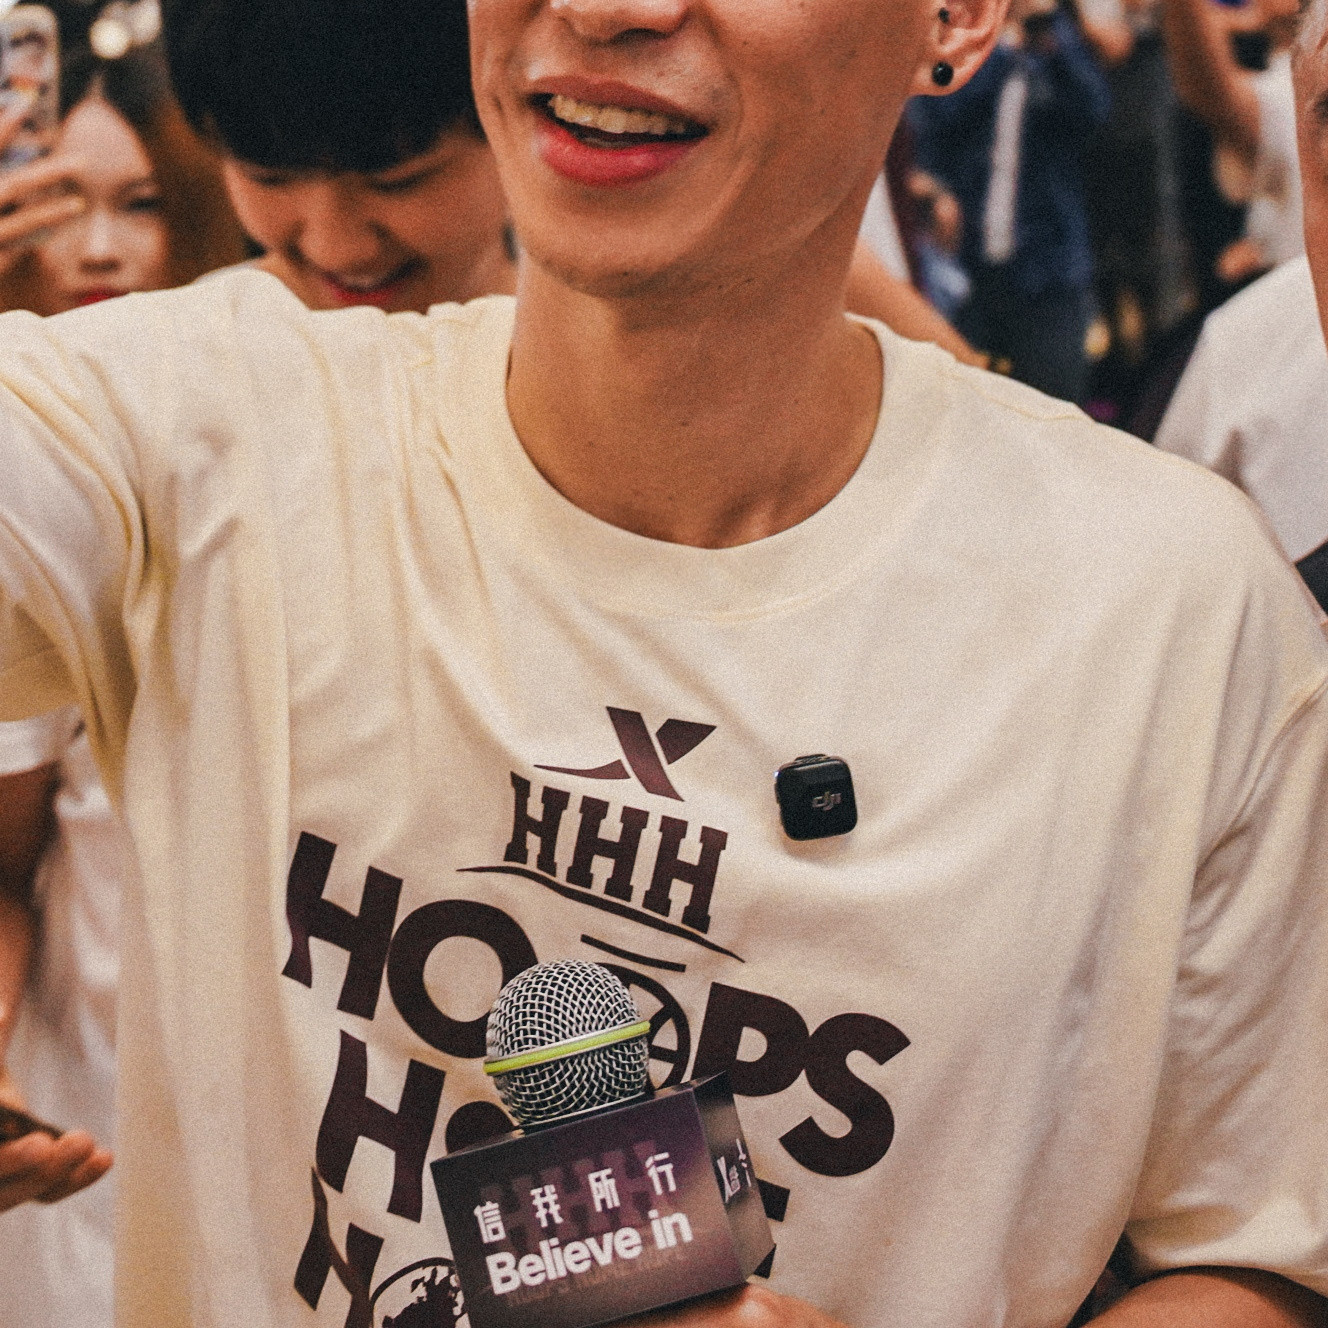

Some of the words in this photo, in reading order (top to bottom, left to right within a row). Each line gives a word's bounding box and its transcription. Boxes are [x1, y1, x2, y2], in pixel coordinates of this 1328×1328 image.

[503, 771, 728, 934] HHH
[473, 1152, 677, 1244] 信我所行
[486, 1226, 642, 1295] Believe
[648, 1209, 694, 1250] in
